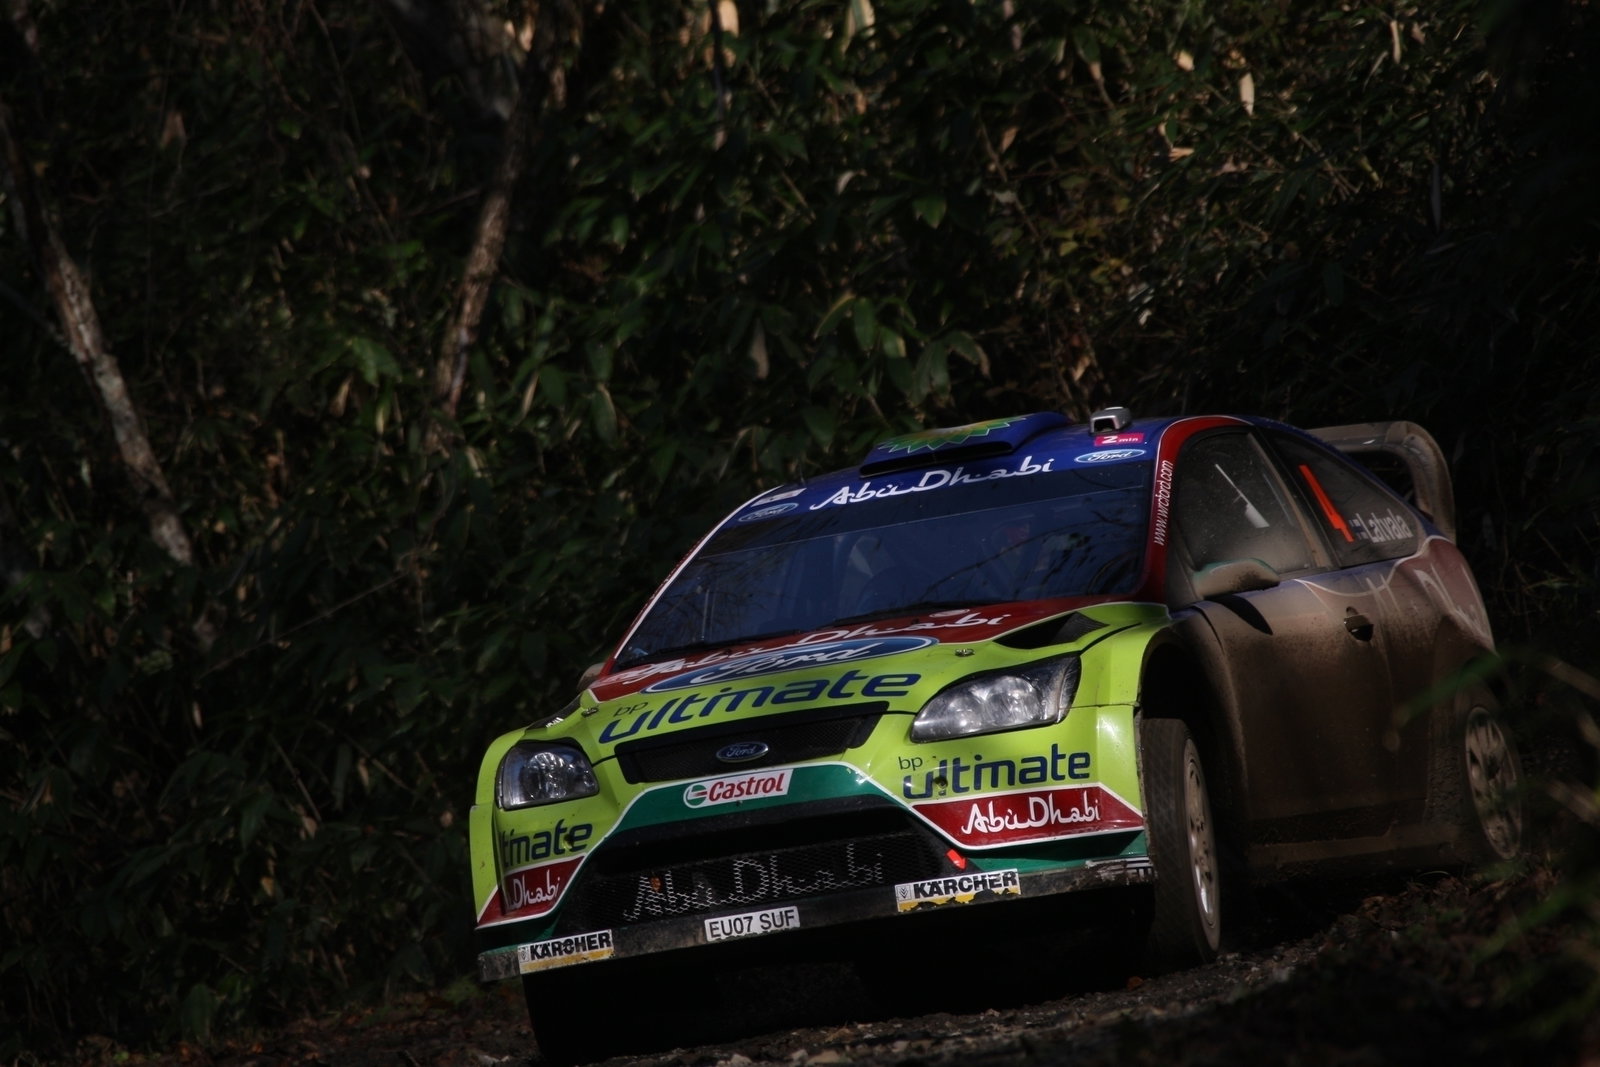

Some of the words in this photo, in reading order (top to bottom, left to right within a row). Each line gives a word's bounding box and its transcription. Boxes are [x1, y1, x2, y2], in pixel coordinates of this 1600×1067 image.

[1101, 436, 1118, 444] 2
[809, 481, 914, 511] Abu
[917, 455, 1055, 489] Dhabi
[1153, 459, 1174, 546] www.wrcford.com
[1298, 463, 1355, 543] 4
[1356, 507, 1414, 543] Latvala
[795, 611, 1012, 646] Dhabi
[689, 640, 884, 684] Ford
[598, 669, 922, 744] ultimate
[613, 702, 648, 717] bp
[898, 756, 923, 771] bp
[903, 743, 1091, 799] ultimate
[708, 773, 785, 802] Castrol
[961, 803, 1028, 835] Abu
[1027, 791, 1101, 828] Dhabi
[511, 869, 561, 910] Dhabi
[622, 870, 714, 922] Abu
[729, 843, 885, 903] Dhabi
[913, 870, 1018, 899] KÄRCHER
[709, 916, 743, 938] EU07
[759, 909, 795, 930] SUF
[530, 932, 612, 961] KÄRCHER
